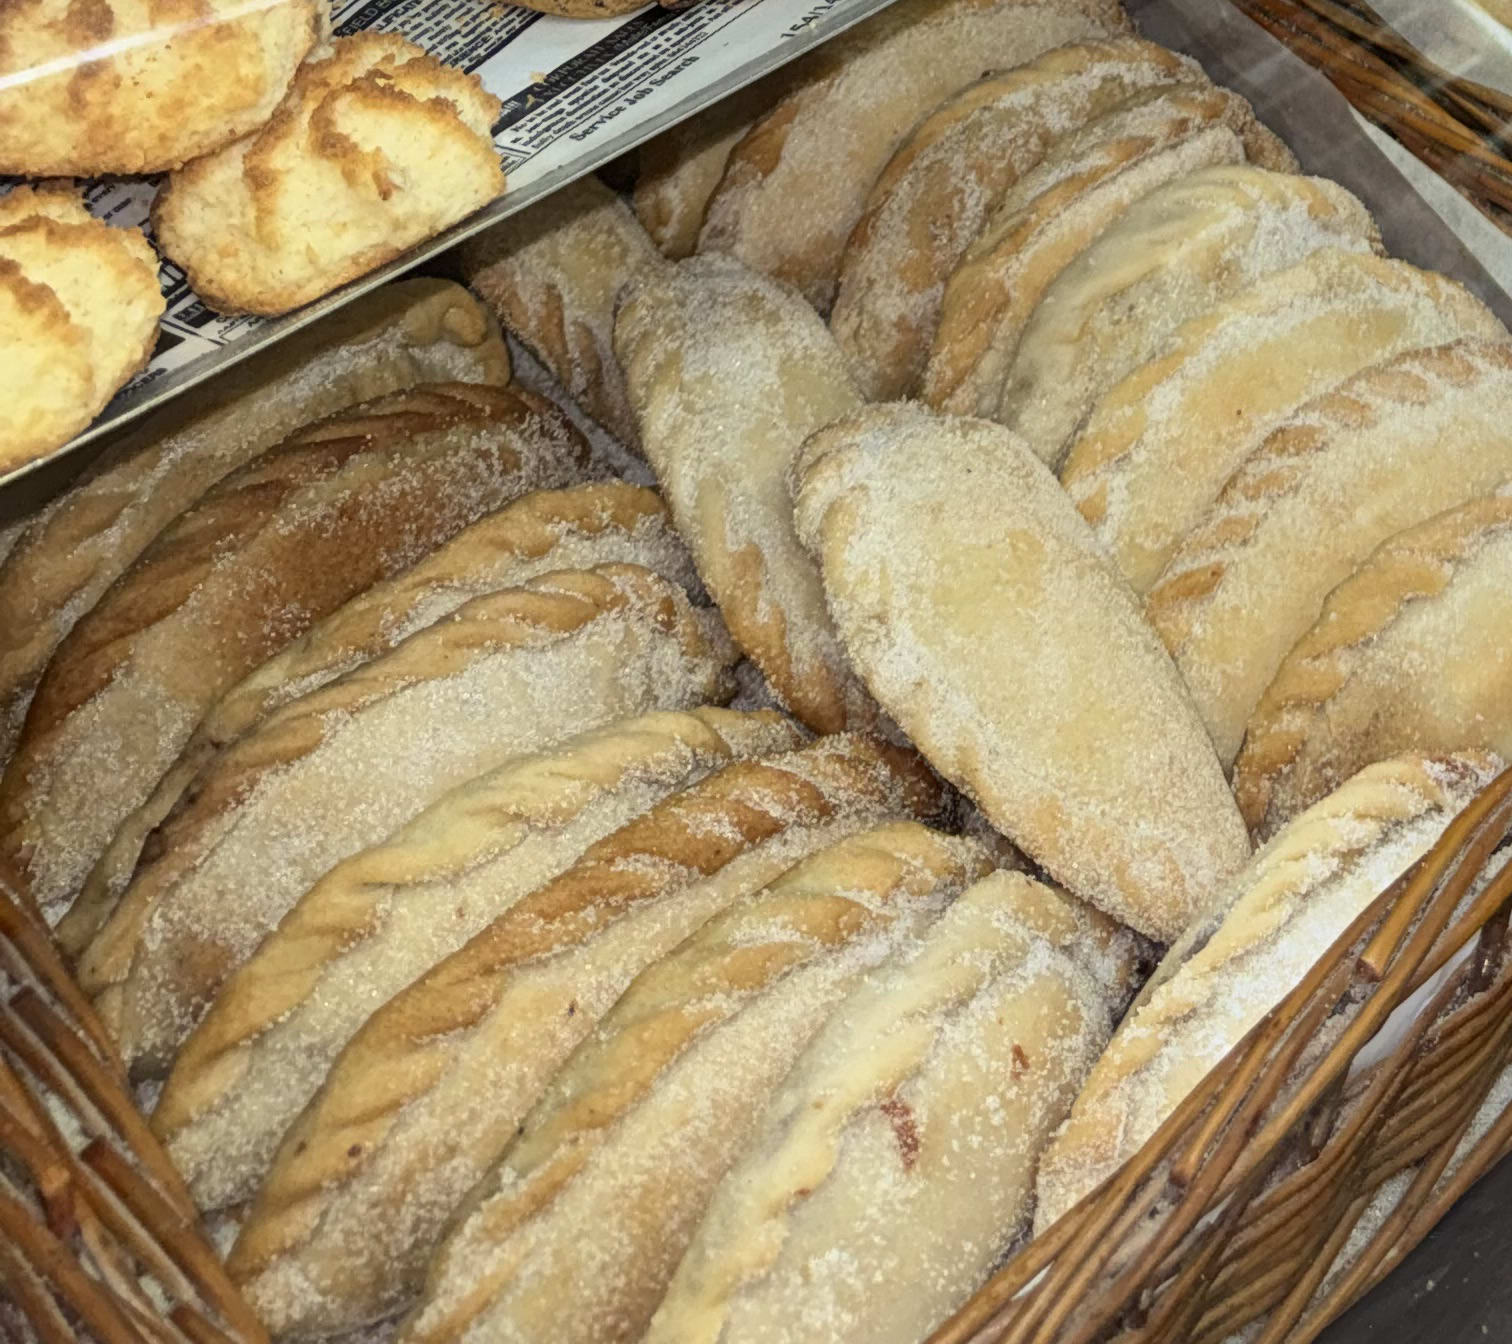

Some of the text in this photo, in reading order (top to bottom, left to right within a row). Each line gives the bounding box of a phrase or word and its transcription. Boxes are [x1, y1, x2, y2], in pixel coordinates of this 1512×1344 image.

[569, 56, 700, 141] Service Job Search
